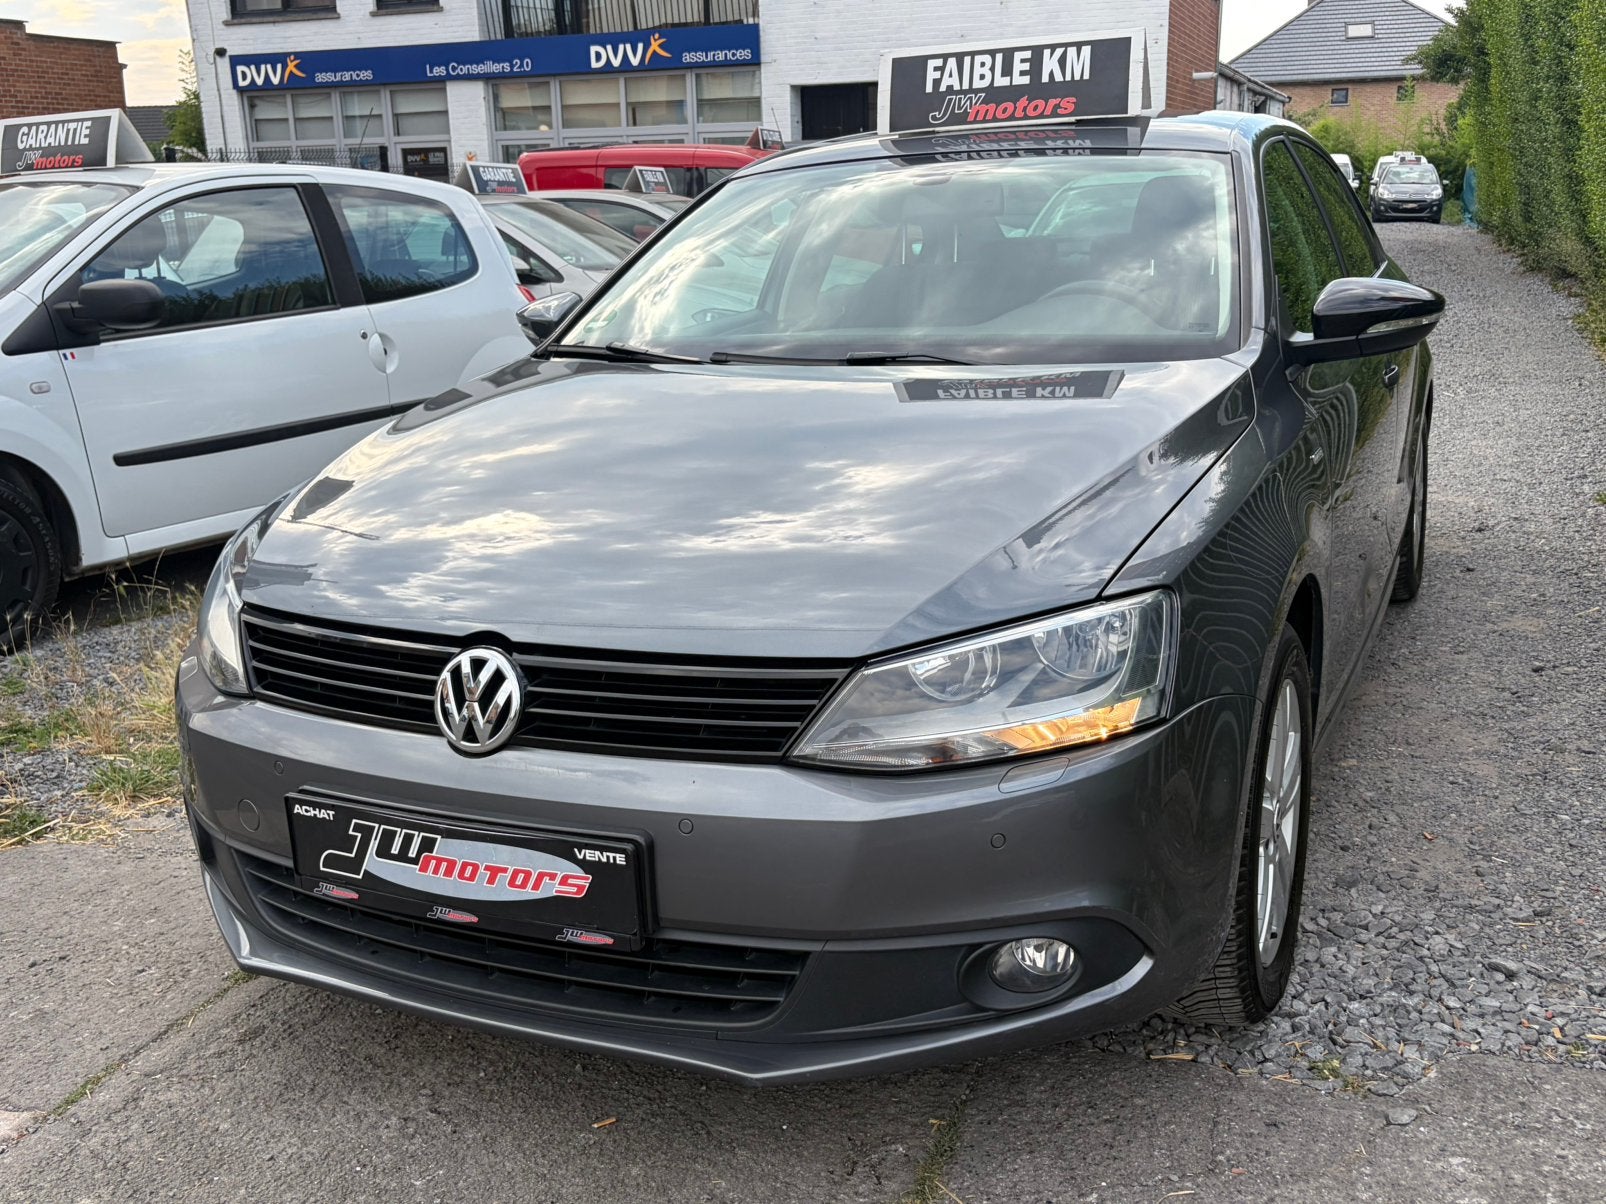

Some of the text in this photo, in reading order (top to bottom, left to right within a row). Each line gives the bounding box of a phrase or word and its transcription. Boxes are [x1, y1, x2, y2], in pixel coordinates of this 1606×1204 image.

[590, 42, 752, 69] DVV assurances
[236, 63, 374, 87] DVV assurances
[426, 58, 532, 77] Les Conseillers 2.0
[925, 45, 1092, 94] FAIBLE KM
[967, 96, 1077, 122] motors
[17, 121, 92, 150] GARANTIE
[34, 153, 84, 170] motors
[479, 166, 517, 182] GARANTIE
[293, 804, 336, 821] ACHAT
[573, 847, 627, 865] VENTE
